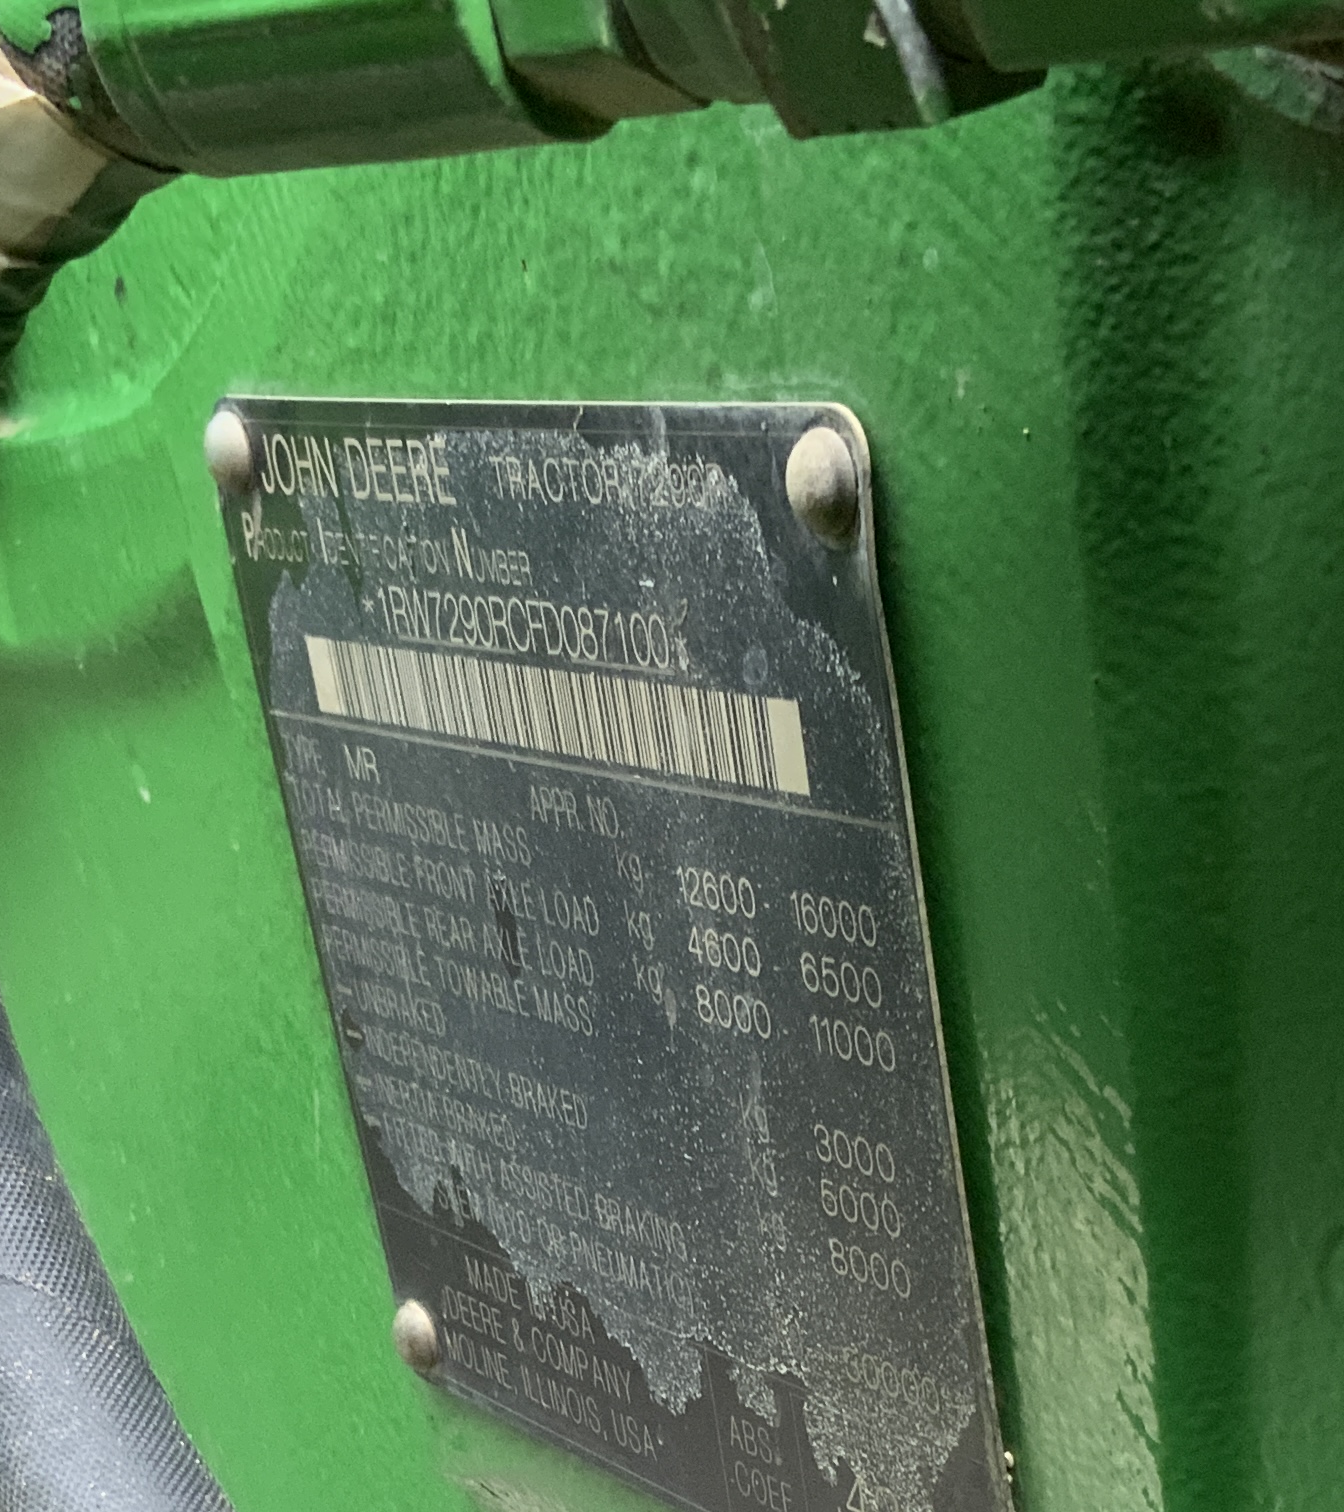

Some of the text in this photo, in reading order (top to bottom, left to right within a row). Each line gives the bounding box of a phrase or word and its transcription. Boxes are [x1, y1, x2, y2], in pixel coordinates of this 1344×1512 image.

[261, 433, 339, 499] JOHN
[344, 436, 457, 505] DEERE
[489, 455, 623, 505] TRACTOR
[315, 516, 450, 582] IDENTFCATON
[451, 525, 533, 587] NUMBER
[281, 731, 326, 777] TYPE
[342, 743, 381, 785] MR
[284, 769, 877, 949] TOTAL PERMISSIBLE MASS kg 12600 16000
[300, 828, 882, 1009] PERMISSIBLE FRONT AXLE LOAD kg 4600 6500
[310, 877, 422, 940] PERMISSIBLE
[423, 906, 476, 952] REAR
[482, 924, 533, 972] AXLE
[537, 935, 595, 987] LOAD
[695, 984, 772, 1040] 8000
[810, 1014, 896, 1073] 11000
[321, 922, 593, 1037] PERMISSIBLE TOWABLE MASS
[354, 978, 447, 1038] UNBRAKED
[813, 1123, 896, 1183] 3000
[508, 1071, 588, 1130] BRAKED
[499, 1156, 591, 1222] ASSISTED
[594, 1190, 689, 1264] BRAKING
[464, 1254, 523, 1311] MADE
[549, 1288, 597, 1347] USA
[828, 1237, 911, 1299] 8000
[442, 1325, 658, 1463] MOLINE, ILLINOIS, USA
[511, 1316, 525, 1354] &
[530, 1325, 632, 1405] COMPANY
